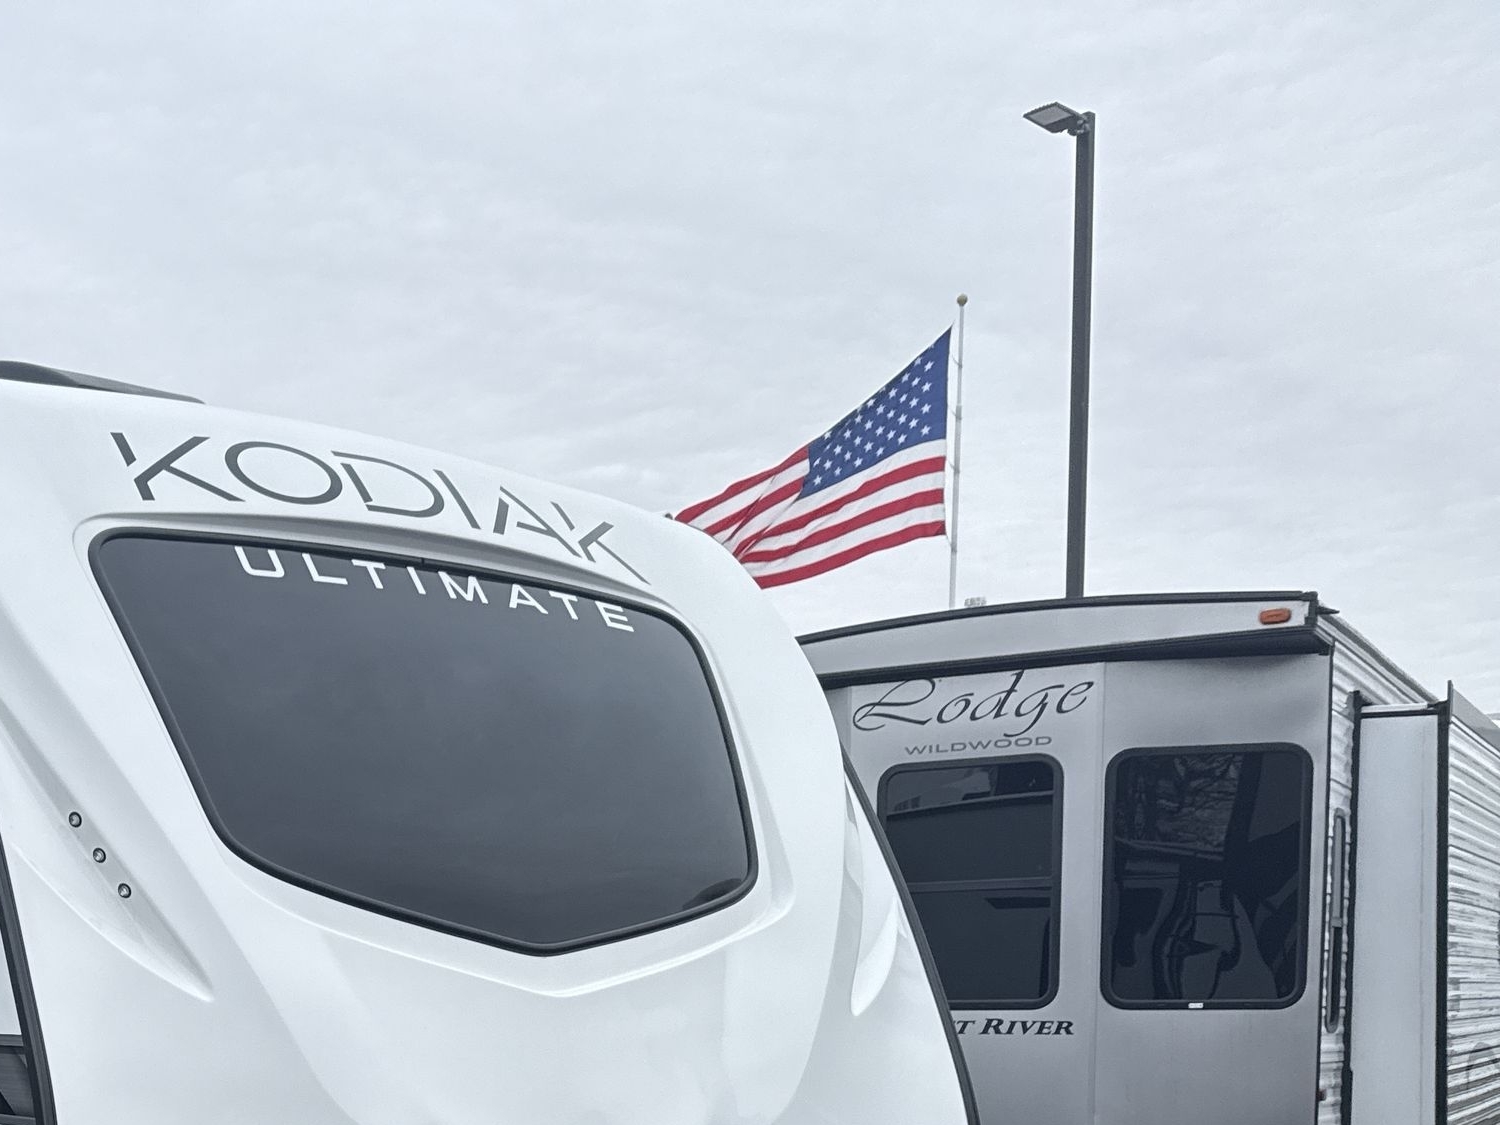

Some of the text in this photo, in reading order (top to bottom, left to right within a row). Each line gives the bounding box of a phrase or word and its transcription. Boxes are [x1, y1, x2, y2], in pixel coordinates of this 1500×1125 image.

[109, 431, 652, 586] KODIAK
[233, 545, 635, 632] ULTIMATE
[853, 669, 1094, 737] Lodge
[905, 736, 1053, 755] WILDWOOD
[979, 1018, 1074, 1035] RIVER
